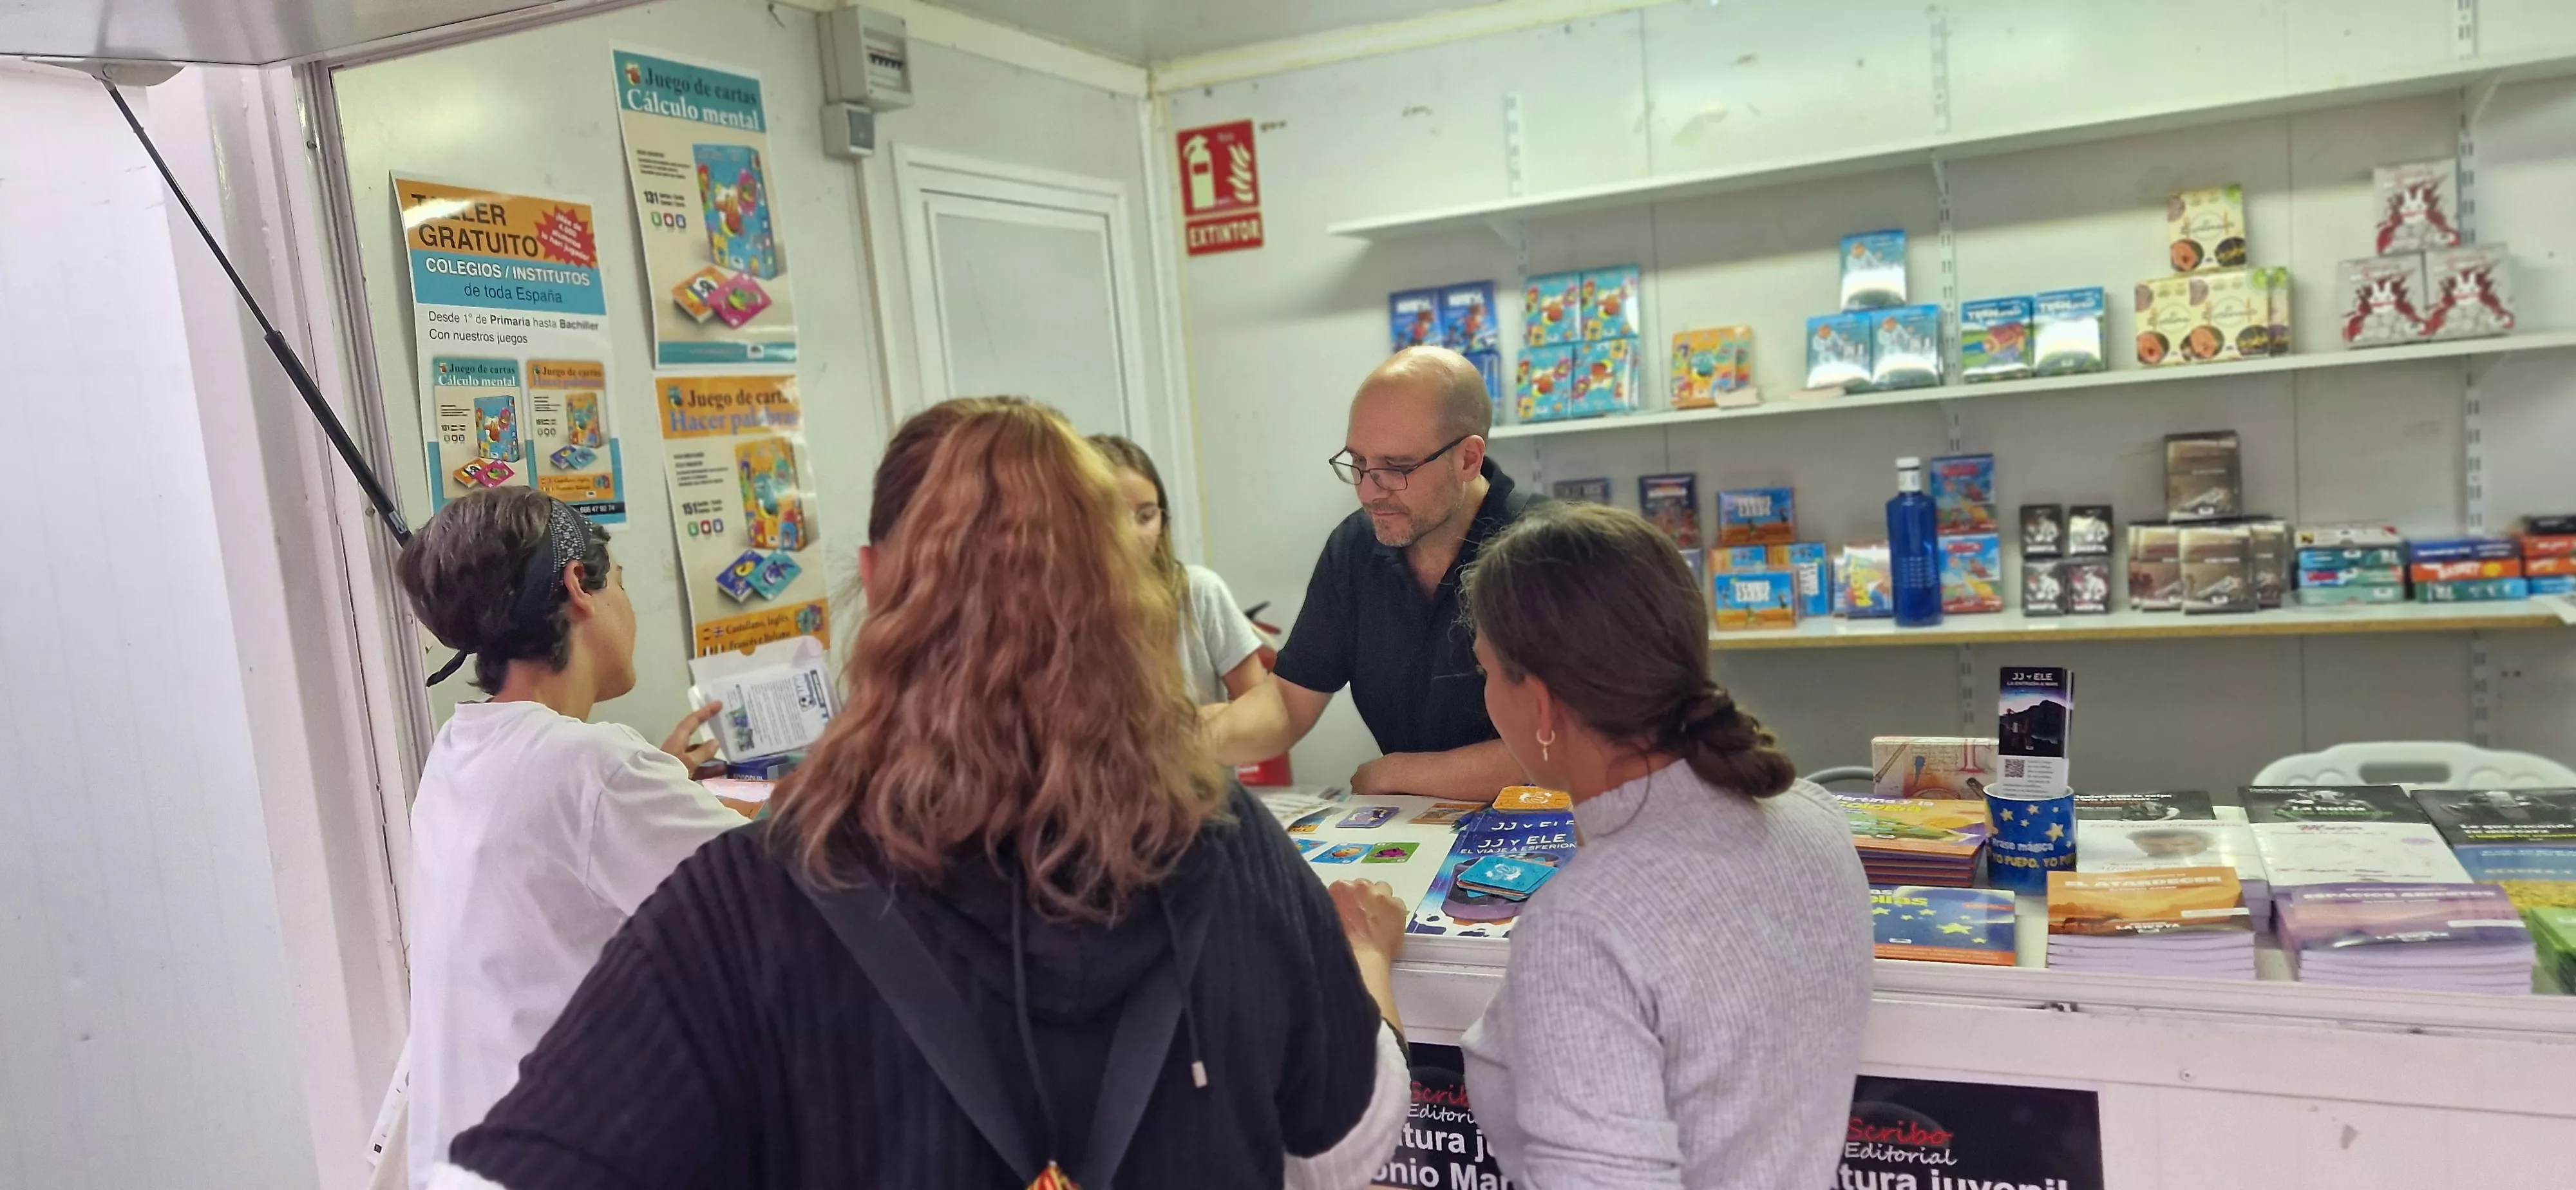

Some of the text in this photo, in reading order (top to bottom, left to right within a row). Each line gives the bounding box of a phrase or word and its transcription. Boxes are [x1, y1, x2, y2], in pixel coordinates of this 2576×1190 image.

[645, 67, 757, 104] Juego de cartas
[627, 88, 760, 131] Cálculo mental
[418, 222, 539, 258] GRATUITO
[425, 257, 502, 279] COLEGIOS
[512, 266, 590, 287] INSTITUTOS
[464, 283, 563, 305] de toda España
[428, 310, 460, 323] Desde
[475, 314, 488, 325] de
[490, 315, 531, 328] Primaria
[533, 317, 557, 329] hasta
[559, 319, 600, 331] Bachiller
[429, 329, 529, 346] Con nuestros juegos
[450, 363, 476, 375] Juego
[477, 364, 488, 374] de
[542, 366, 566, 379] Juego
[567, 367, 576, 377] de
[438, 374, 516, 386] Cálculo mental
[688, 389, 732, 409] Juego
[736, 389, 752, 406] de
[669, 410, 724, 431] Hacer
[1477, 838, 1504, 848] JJ
[1526, 833, 1567, 845] ELE
[1399, 1122, 1466, 1154] tura
[1846, 1119, 1954, 1146] Scribo
[1844, 1142, 1958, 1166] Editorial
